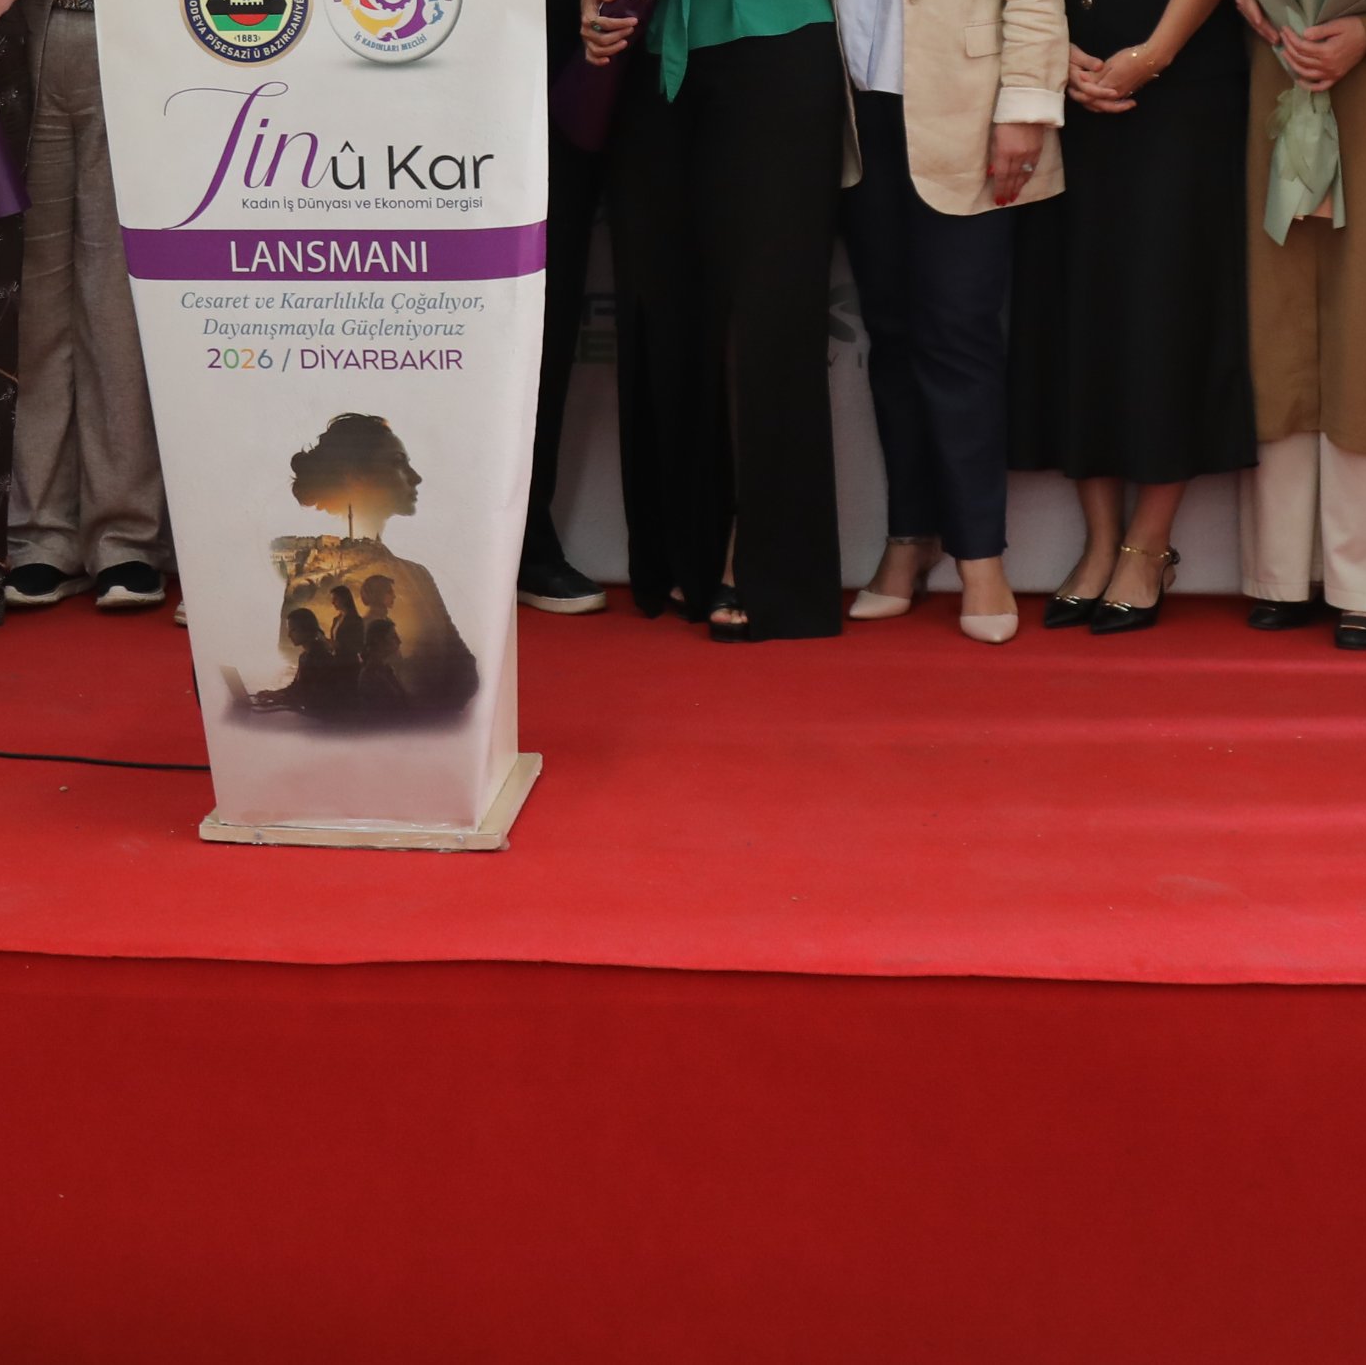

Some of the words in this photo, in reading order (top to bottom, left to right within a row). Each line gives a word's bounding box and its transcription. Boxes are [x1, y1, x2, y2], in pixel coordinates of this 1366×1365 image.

[189, 0, 207, 35] ODEYA
[236, 34, 258, 43] 1883
[361, 37, 400, 52] KADINLARI
[161, 81, 333, 230] Jin
[331, 140, 365, 190] û
[387, 145, 494, 190] Kar
[242, 197, 280, 210] Kadın
[284, 196, 294, 213] İş
[297, 197, 352, 213] Dünyası
[355, 200, 371, 210] ve
[375, 196, 432, 210] Ekonomi
[436, 196, 483, 213] Dergisi
[230, 240, 428, 273] LANSMANI
[181, 292, 250, 309] Cesaret
[255, 297, 275, 310] ve
[280, 292, 384, 310] Kararlılıkla
[391, 292, 485, 314] Çoğalıyor,
[203, 318, 334, 340] Dayanışmayla
[341, 318, 465, 341] Güçleniyoruz
[207, 348, 273, 369] 2026
[282, 348, 291, 372] /
[300, 345, 463, 370] DİYARBAKIR
